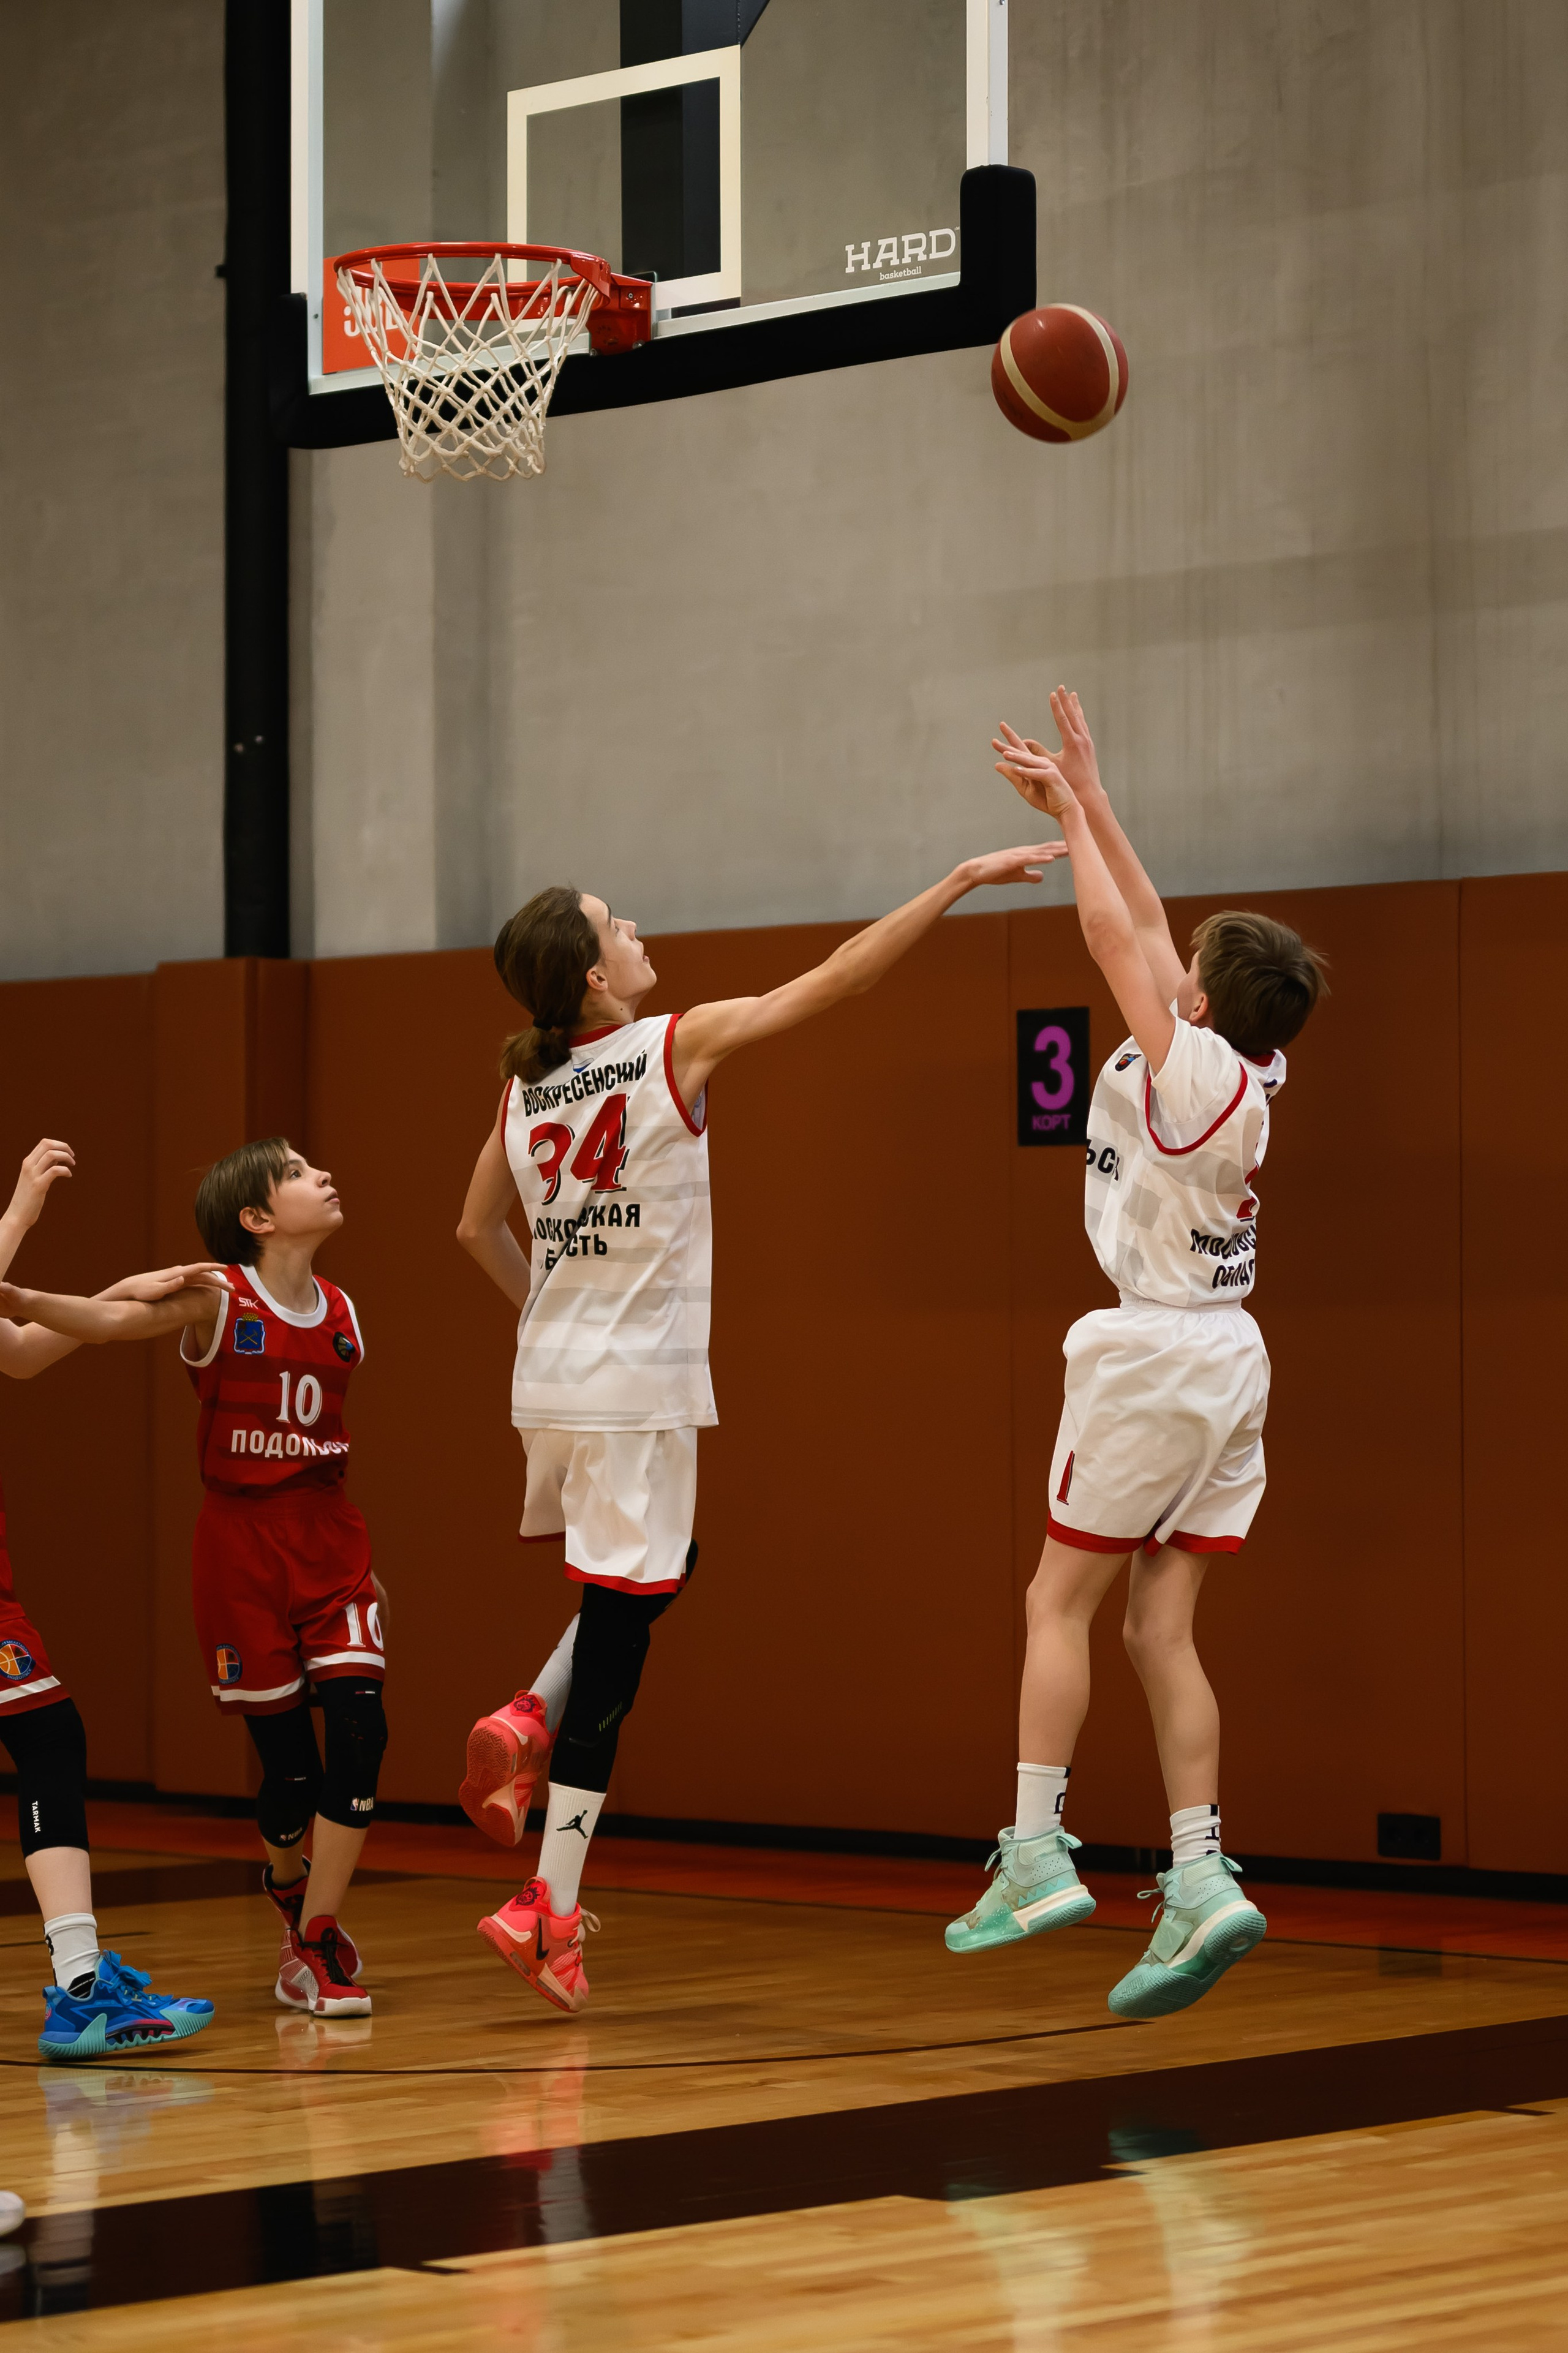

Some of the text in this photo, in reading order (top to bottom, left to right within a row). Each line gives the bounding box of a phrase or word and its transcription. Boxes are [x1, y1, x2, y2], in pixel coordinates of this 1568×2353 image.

[845, 228, 956, 273] HARD
[880, 266, 922, 280] basketball
[1031, 1025, 1075, 1110] 3
[1032, 1115, 1071, 1130] КОРТ
[276, 1371, 323, 1426] 10
[32, 1801, 41, 1833] TARMAK
